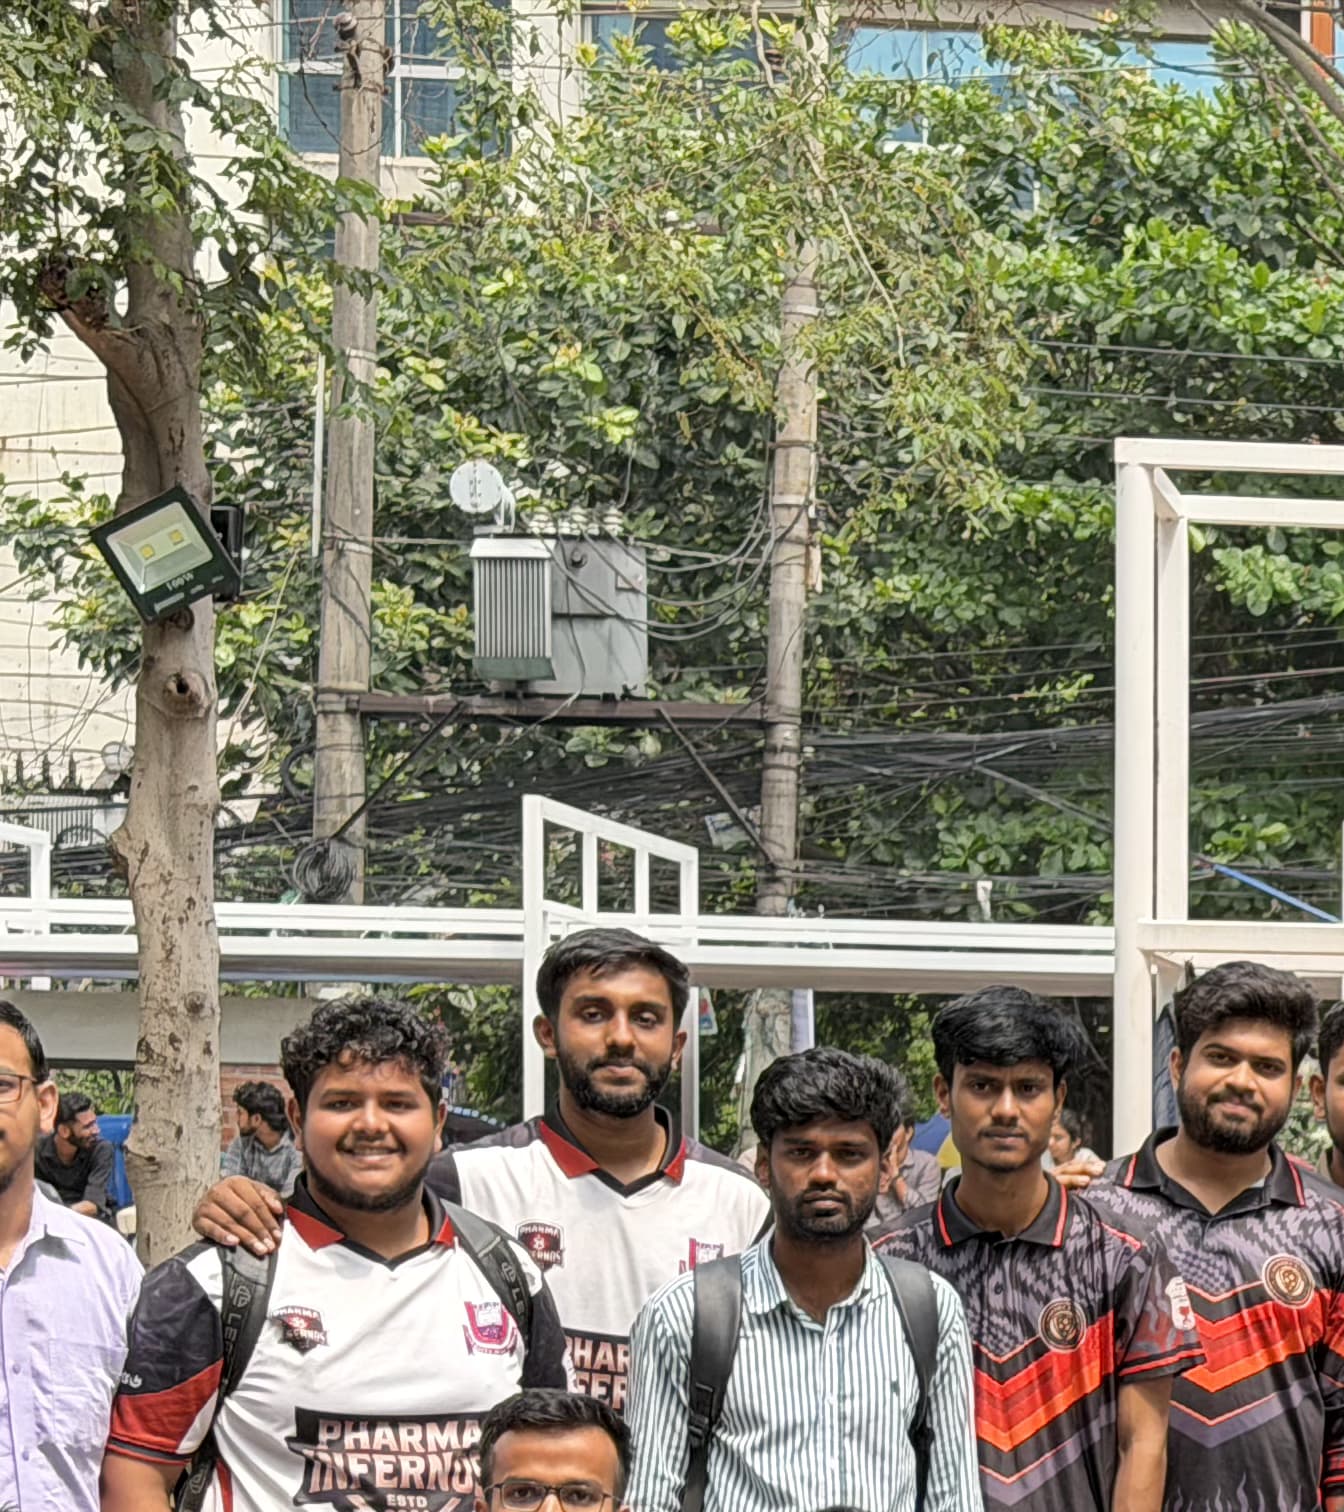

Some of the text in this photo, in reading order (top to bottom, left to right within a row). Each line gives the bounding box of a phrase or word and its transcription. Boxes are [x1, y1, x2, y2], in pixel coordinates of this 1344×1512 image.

[567, 1336, 630, 1373] HAR
[318, 1418, 482, 1450] PHARMA
[386, 1494, 428, 1508] ESTD
